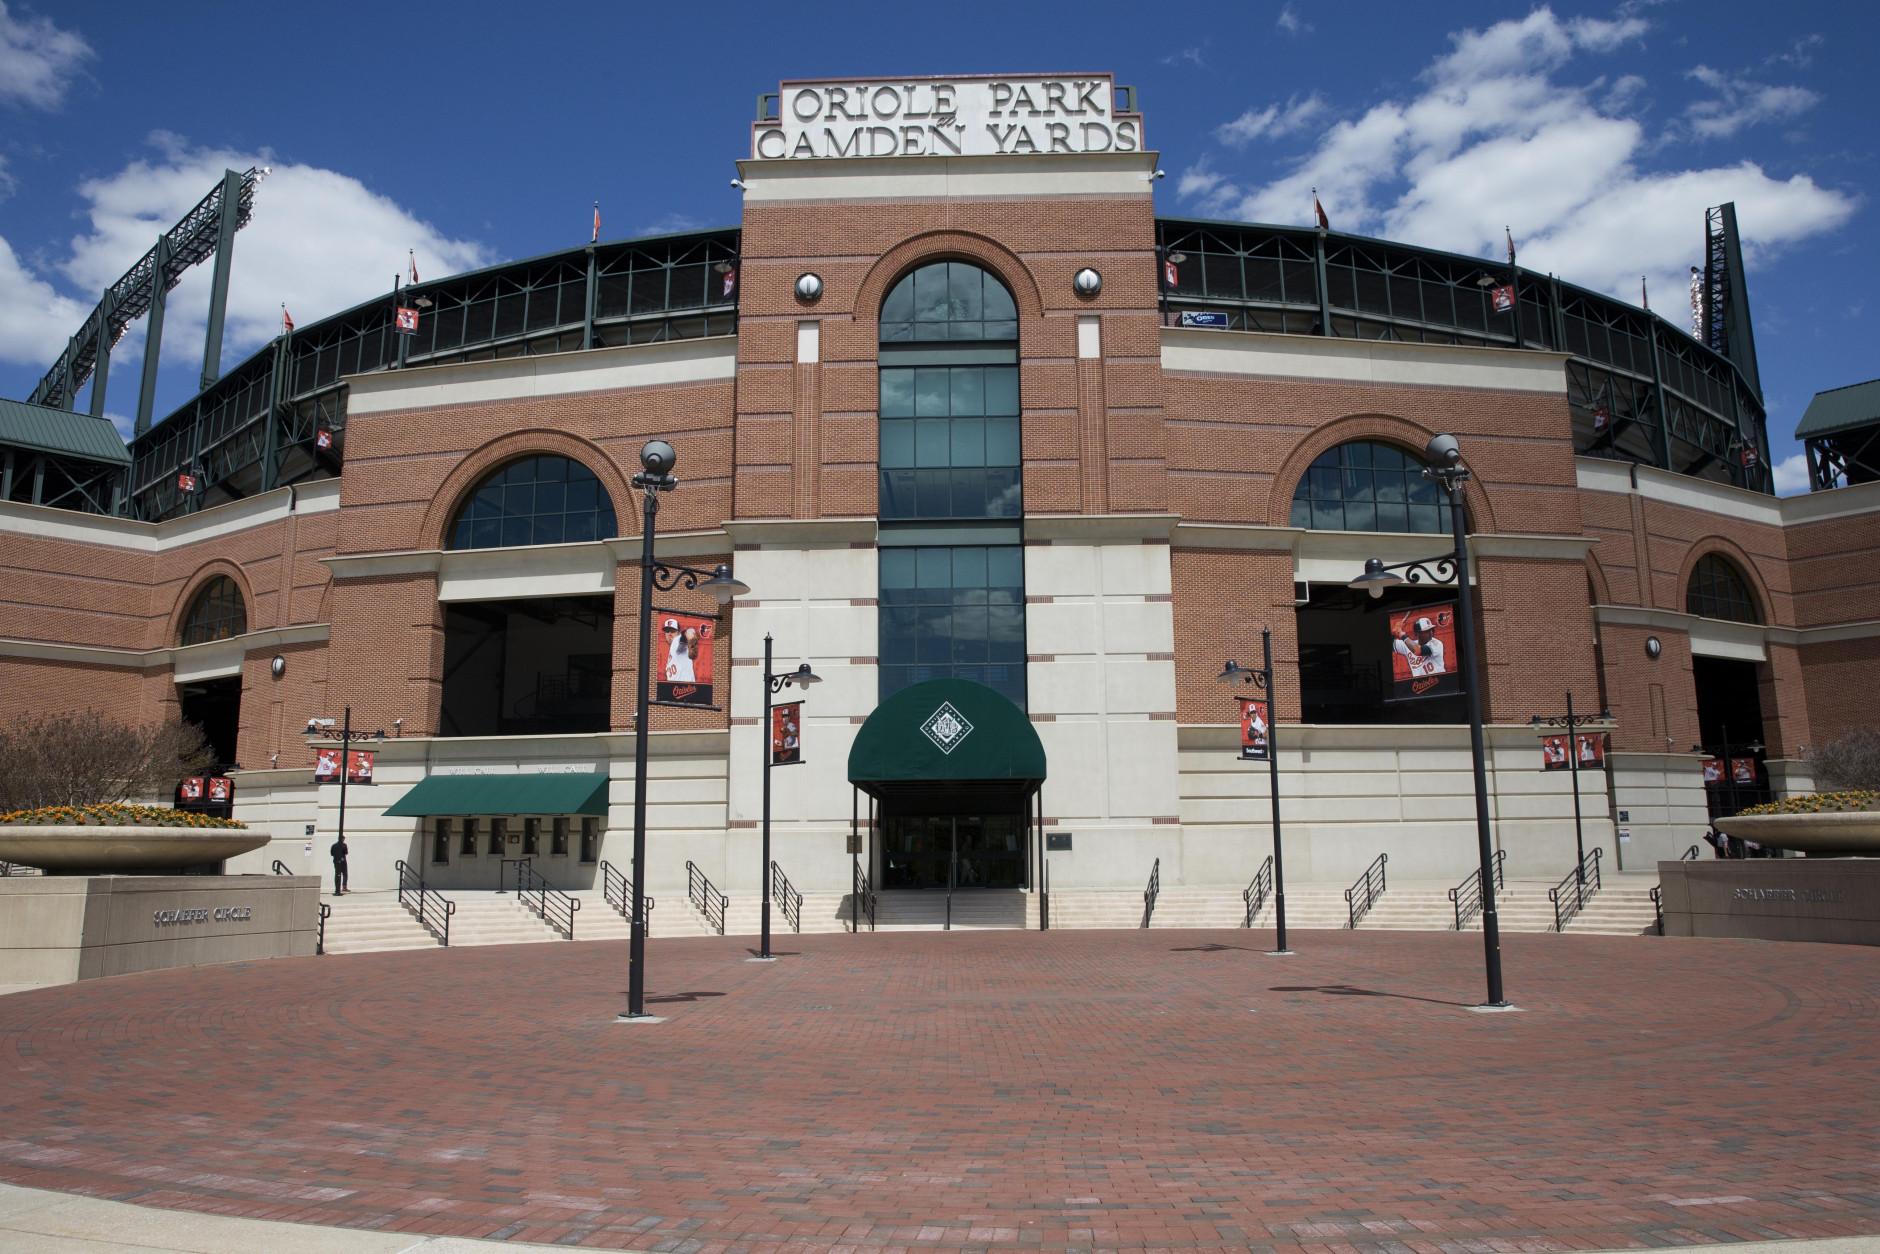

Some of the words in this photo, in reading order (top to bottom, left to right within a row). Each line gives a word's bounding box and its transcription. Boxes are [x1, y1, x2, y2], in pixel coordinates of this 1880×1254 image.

[793, 83, 958, 120] ORIOLE
[988, 80, 1105, 116] PARK
[757, 124, 966, 159] CAMDEN
[985, 121, 1137, 153] YARDS
[153, 909, 208, 924] SCHAEFER
[213, 906, 251, 920] CIRCLE
